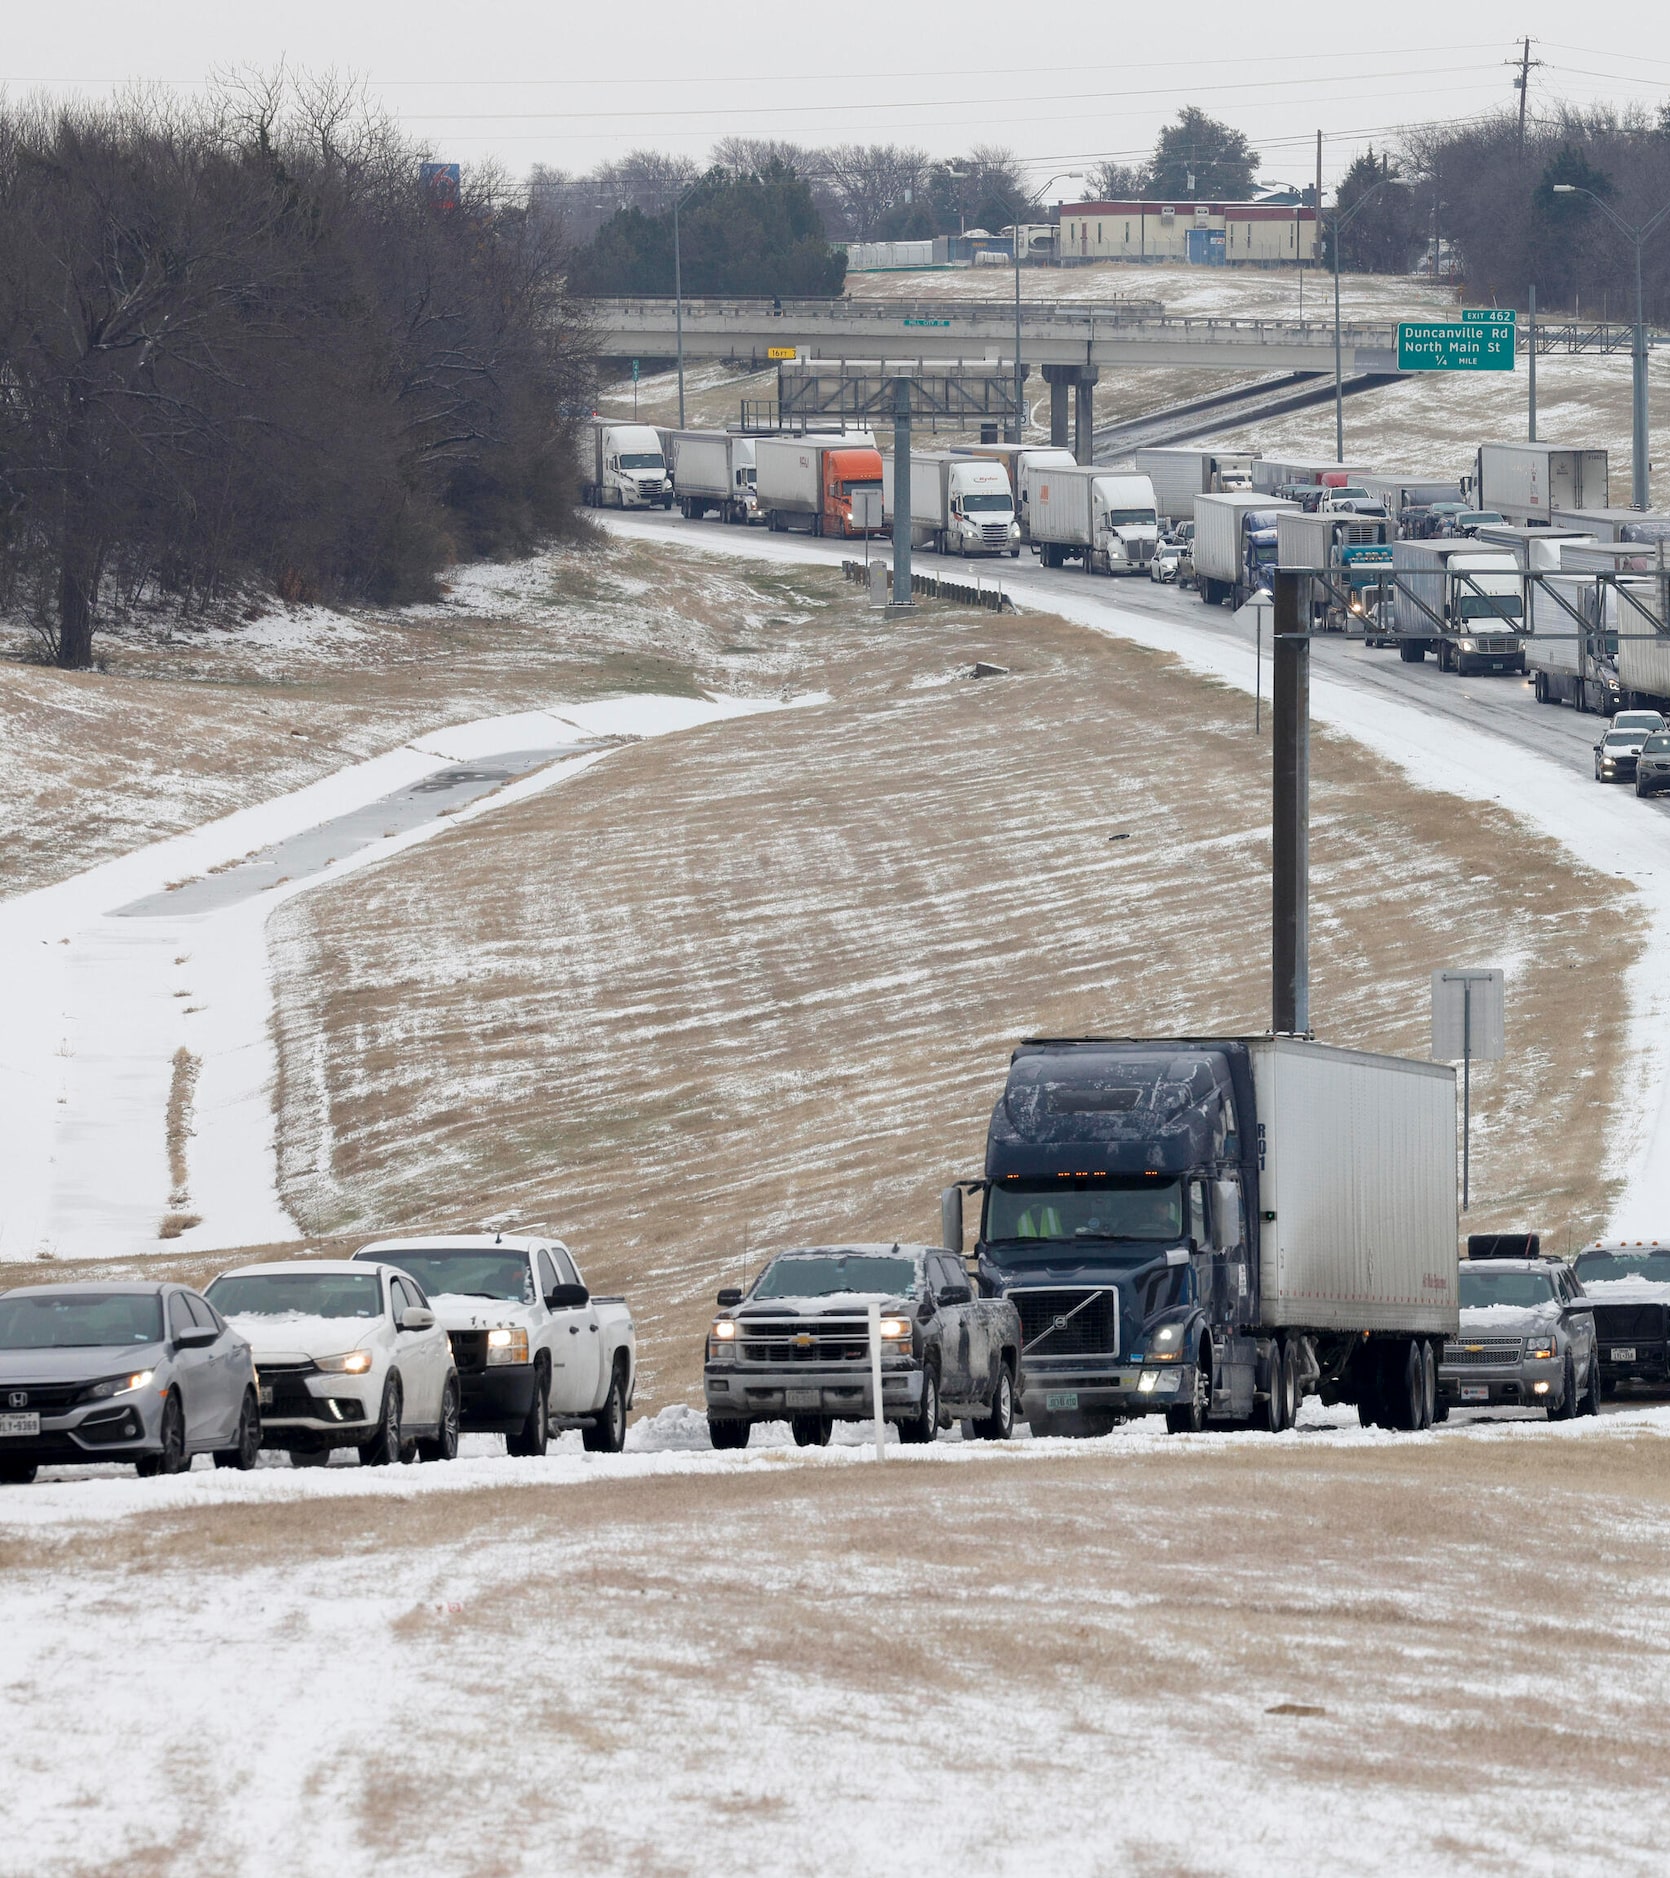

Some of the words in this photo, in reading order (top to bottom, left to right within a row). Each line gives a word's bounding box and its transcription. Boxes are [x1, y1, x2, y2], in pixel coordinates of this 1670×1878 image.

[1467, 312, 1485, 320] EXIT
[1489, 311, 1511, 321] 462
[1405, 327, 1483, 338] Duncanville
[1491, 327, 1508, 339] Rd
[1405, 341, 1442, 353] North
[1449, 341, 1480, 352] Main
[1487, 342, 1501, 353] St
[1458, 357, 1478, 365] MILE
[1257, 1123, 1267, 1171] R01
